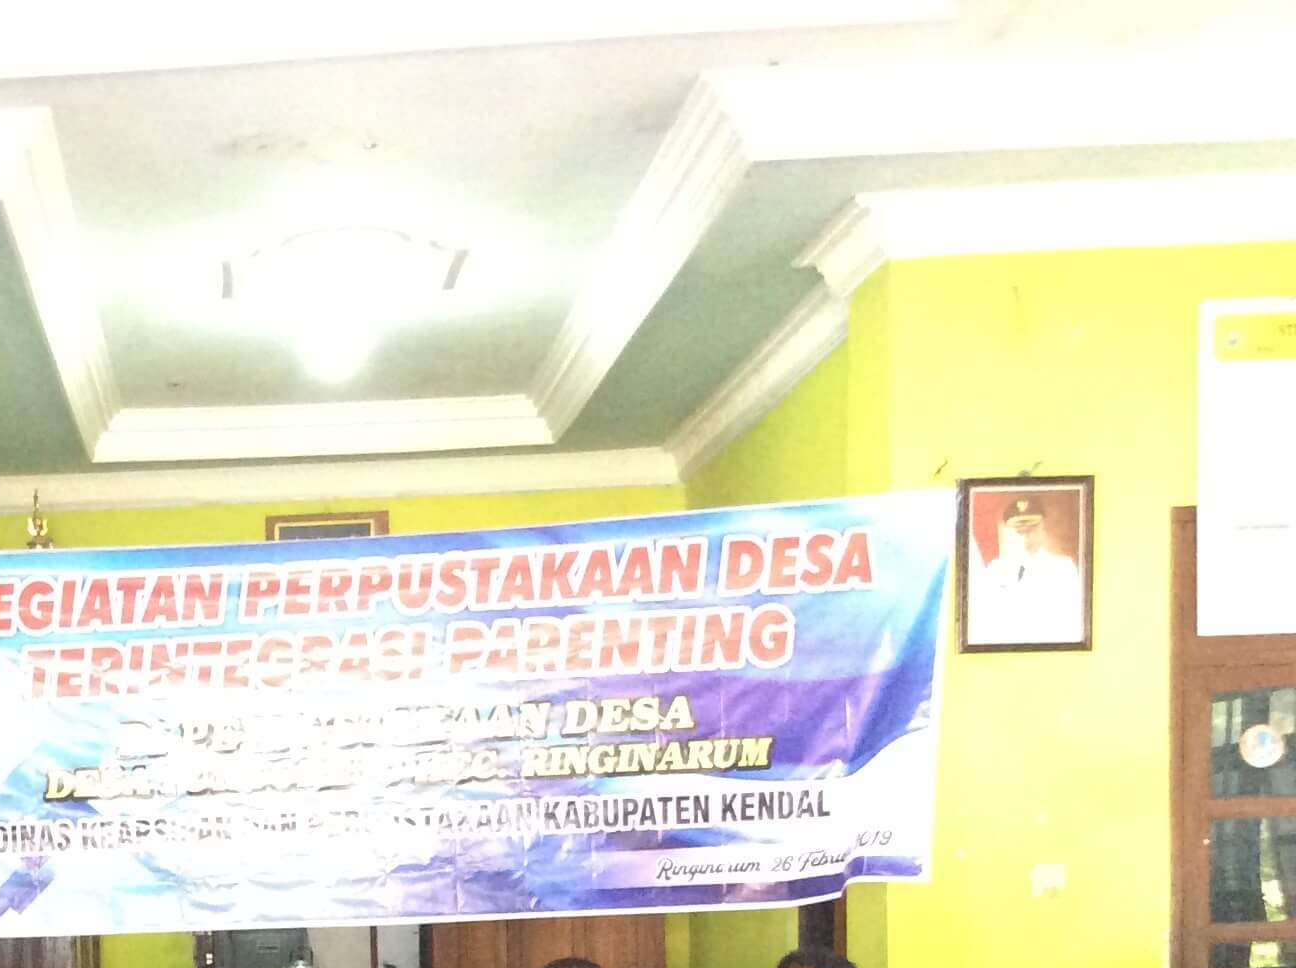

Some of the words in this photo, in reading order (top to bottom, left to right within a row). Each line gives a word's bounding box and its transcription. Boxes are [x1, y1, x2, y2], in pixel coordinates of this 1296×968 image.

[244, 543, 703, 617] PERPUSTAKAAN
[724, 532, 874, 591] DESA
[450, 609, 789, 674] PARENTING
[561, 694, 695, 737] DESA
[522, 736, 773, 779] RINGINARUM
[543, 794, 710, 831] KABUPATEN
[720, 788, 831, 823] KENDAL
[770, 856, 793, 873] 26
